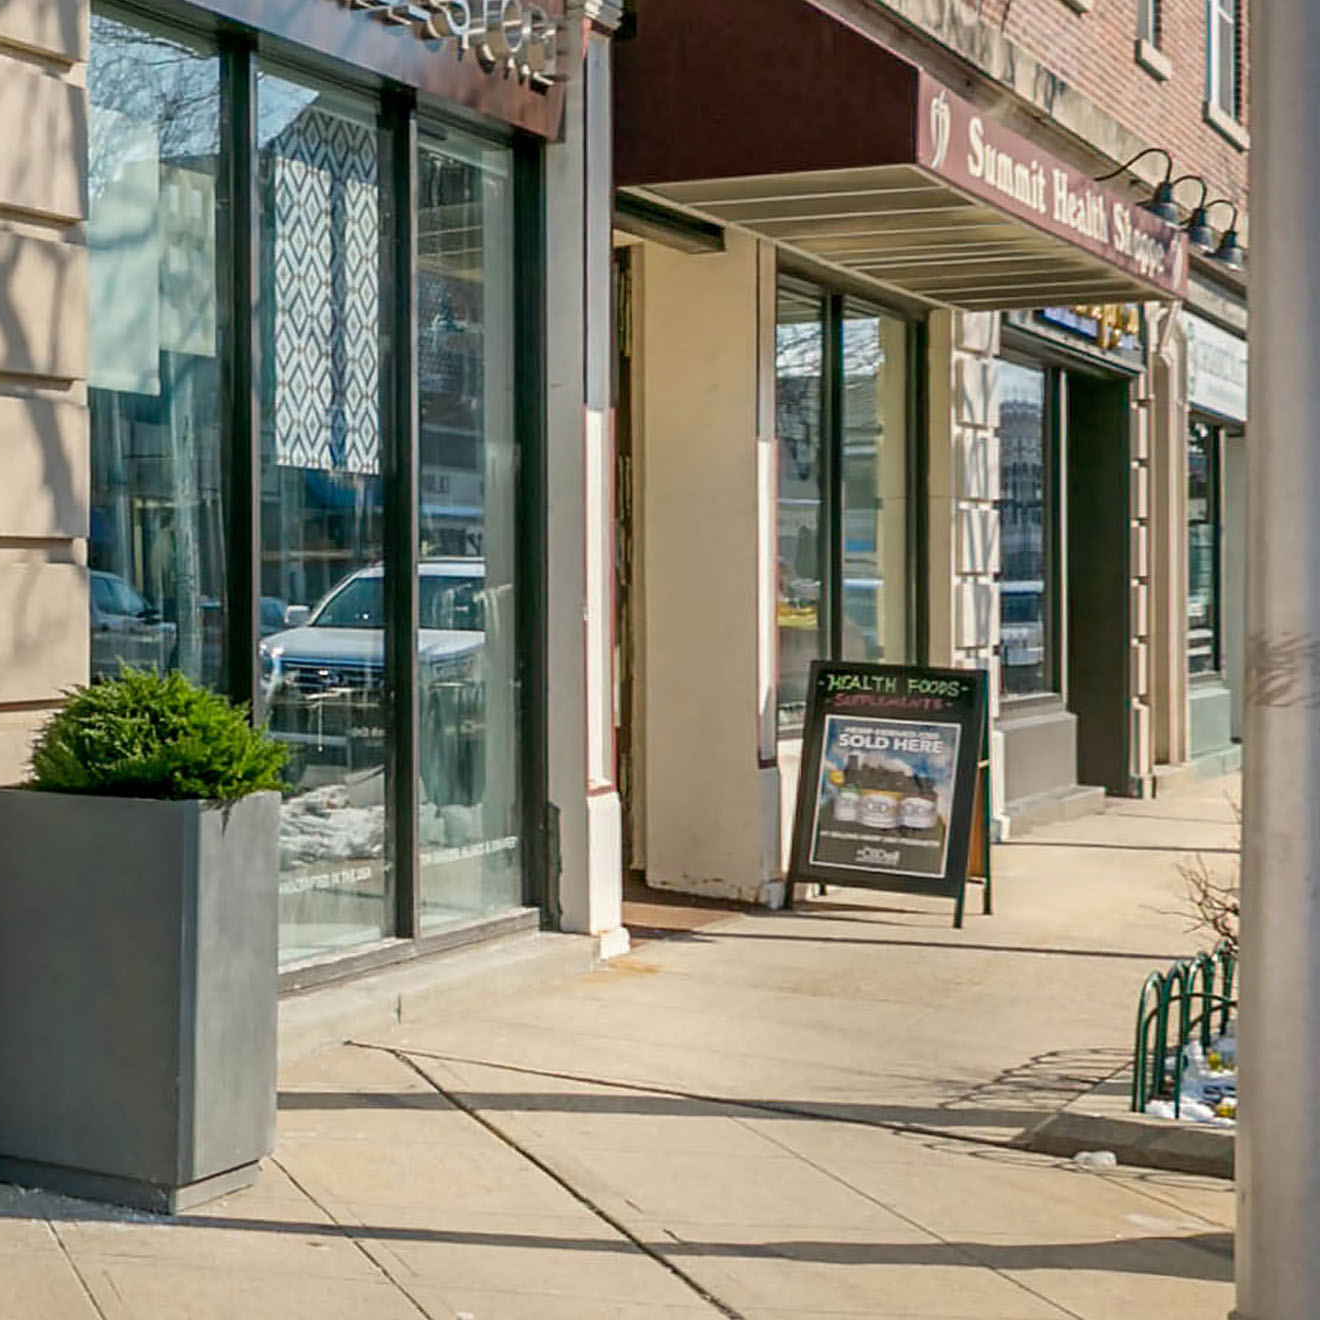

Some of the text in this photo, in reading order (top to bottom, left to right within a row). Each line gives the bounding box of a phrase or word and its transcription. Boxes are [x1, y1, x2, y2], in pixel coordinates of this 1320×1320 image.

[967, 116, 1047, 214] Summit
[1052, 168, 1109, 244] Health
[827, 674, 959, 698] HEALTH FOODS
[838, 733, 890, 750] SOLD
[893, 738, 944, 754] HERE
